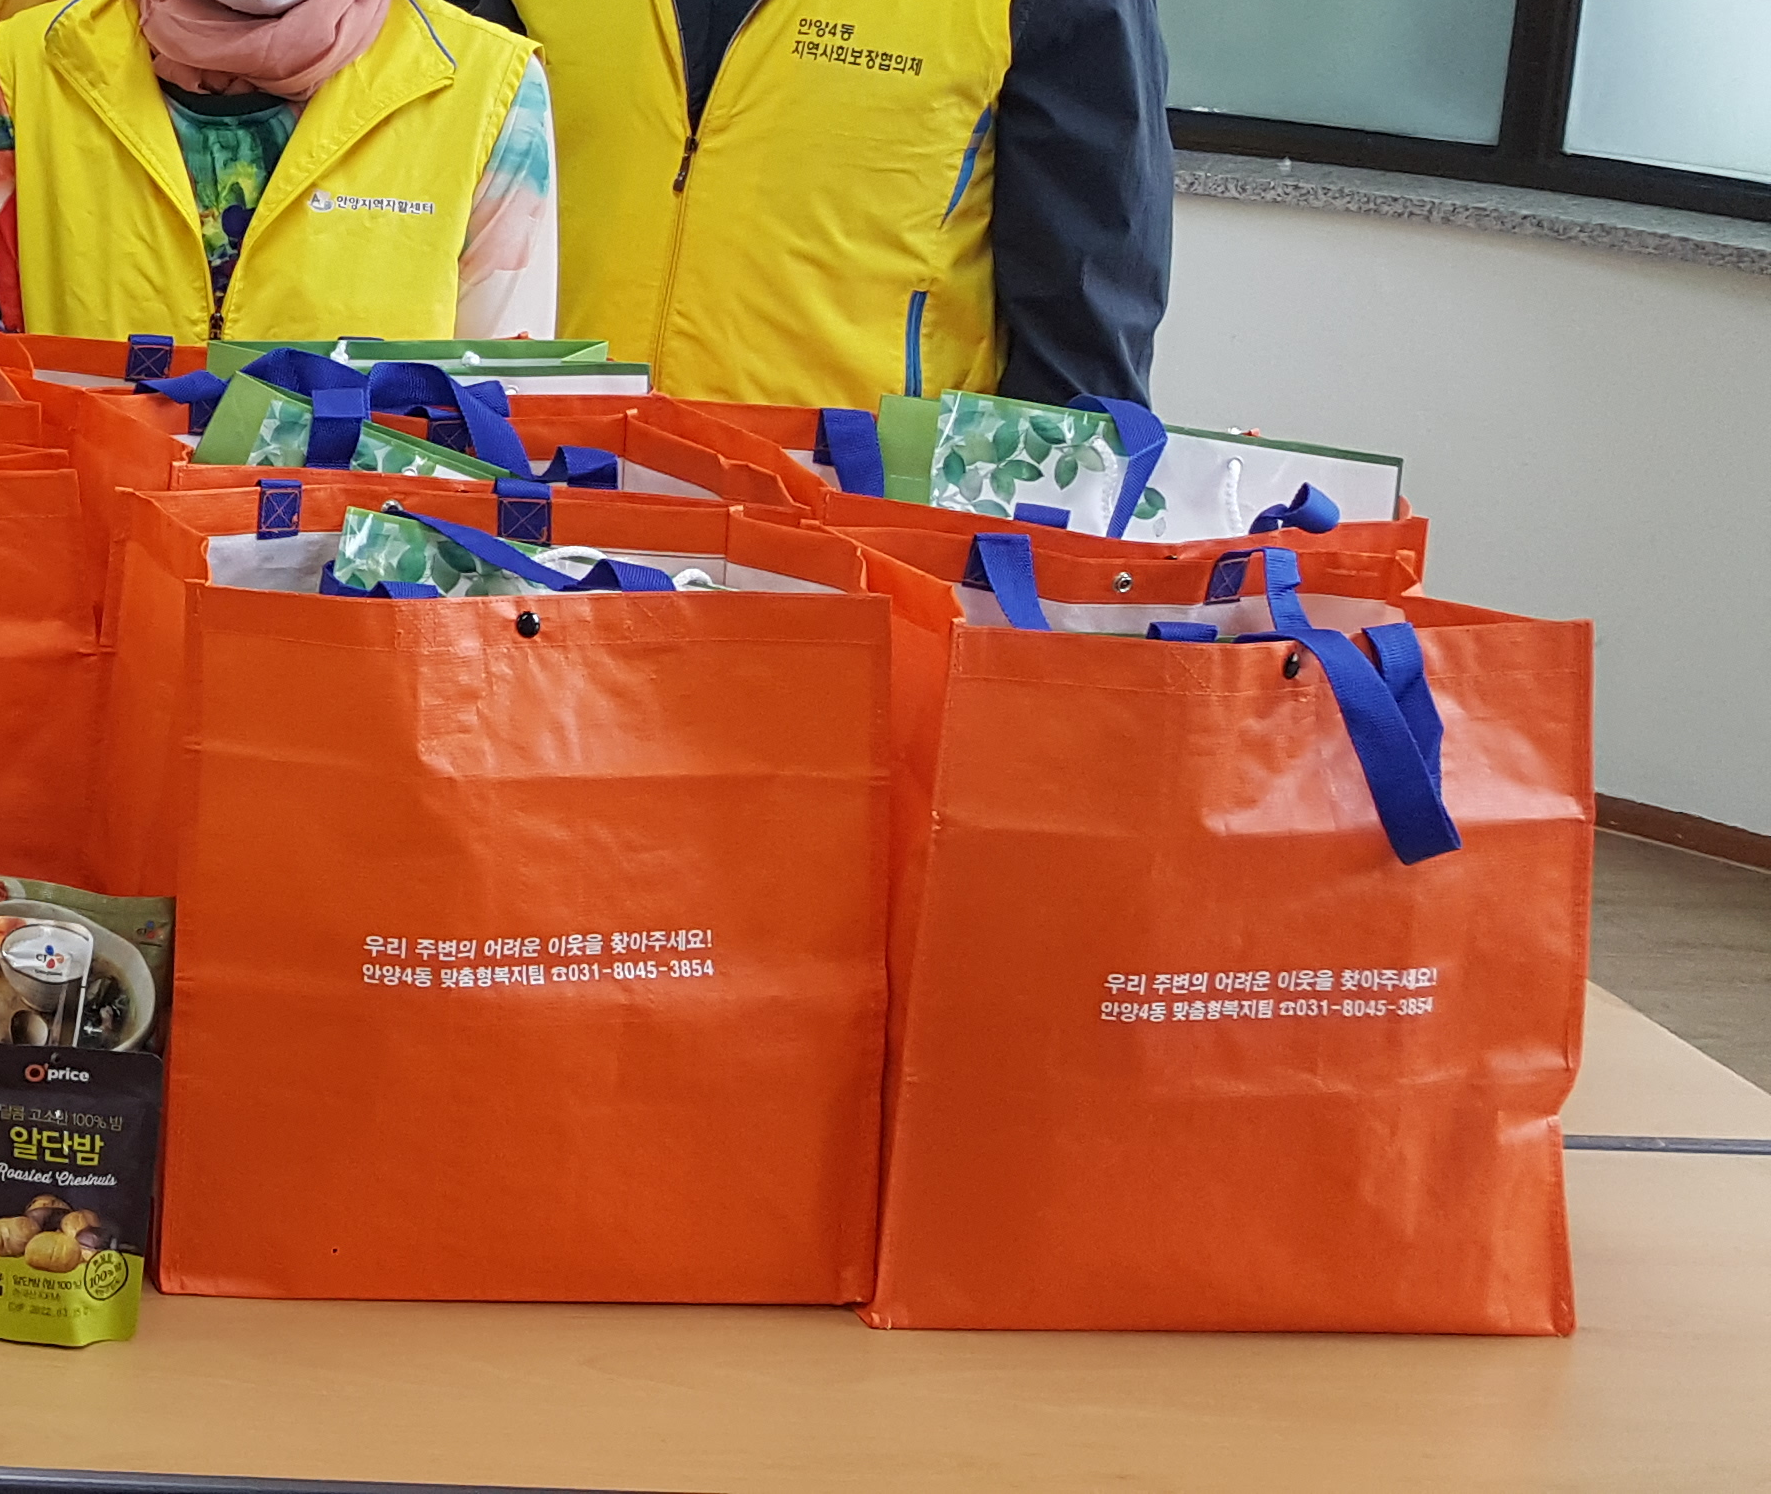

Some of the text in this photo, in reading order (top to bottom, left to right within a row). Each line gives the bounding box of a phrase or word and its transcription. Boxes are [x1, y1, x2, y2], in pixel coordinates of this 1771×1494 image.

[798, 18, 855, 41] 안양4동
[791, 40, 923, 77] 지역사회보장협의체
[335, 195, 434, 215] 안양지역자활센터
[363, 928, 713, 962] 우리 주변의 어려운 이웃을 찾아주세요!
[362, 959, 715, 988] 안양4동 맞춤형복지팀 031-8045-3854
[1104, 967, 1437, 995] 우리 주변의 어려운 이웃을 찾아주세요!
[1100, 996, 1433, 1023] 안양4동 맞춤형복지팀 031-8045-3854
[25, 1063, 90, 1082] O'price
[72, 1112, 107, 1129] 100%
[10, 1126, 104, 1166] 알단밤
[56, 1170, 117, 1186] Chestnuts
